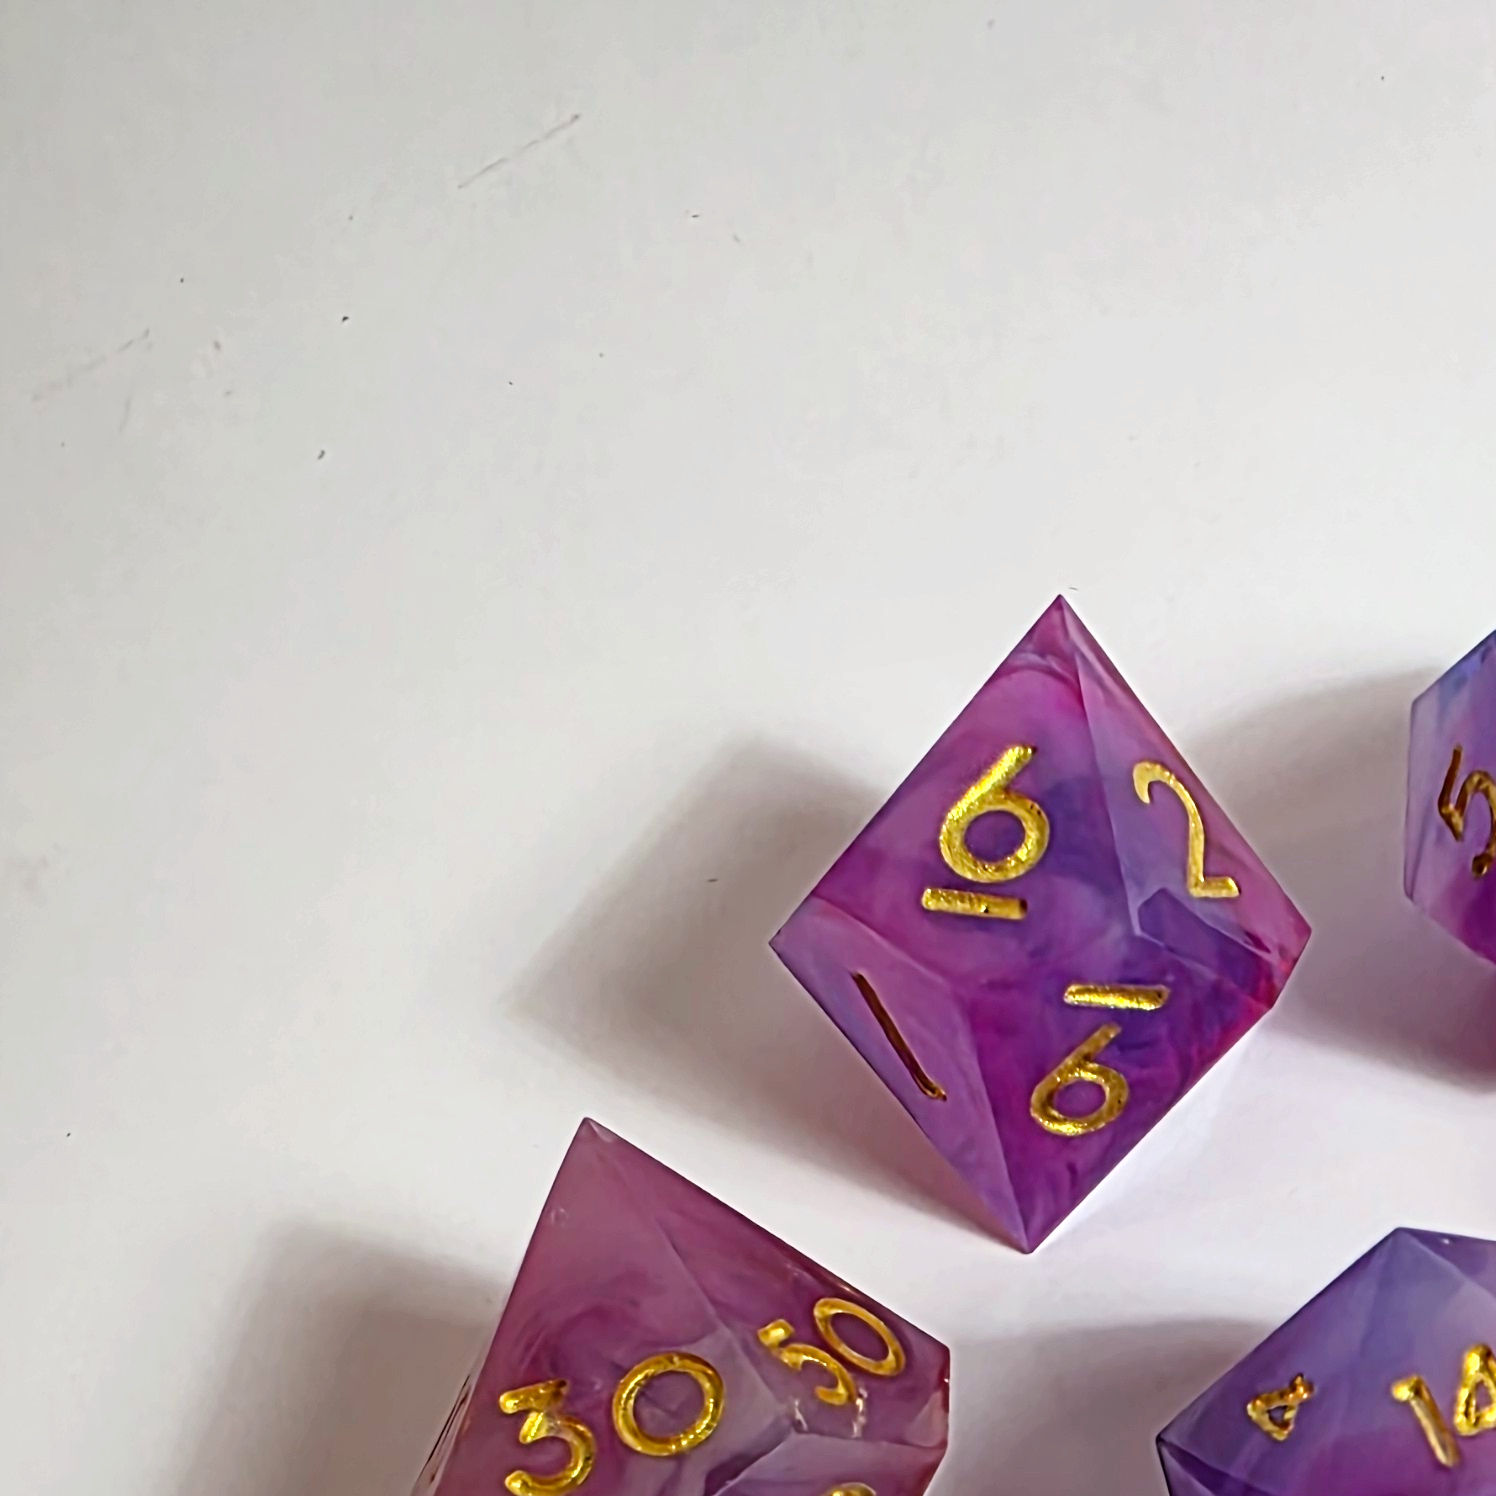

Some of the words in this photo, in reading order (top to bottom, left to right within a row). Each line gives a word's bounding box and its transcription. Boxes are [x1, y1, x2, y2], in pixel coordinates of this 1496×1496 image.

[1132, 760, 1240, 899] 2
[757, 1297, 906, 1406] 50
[1247, 1371, 1315, 1441] 4
